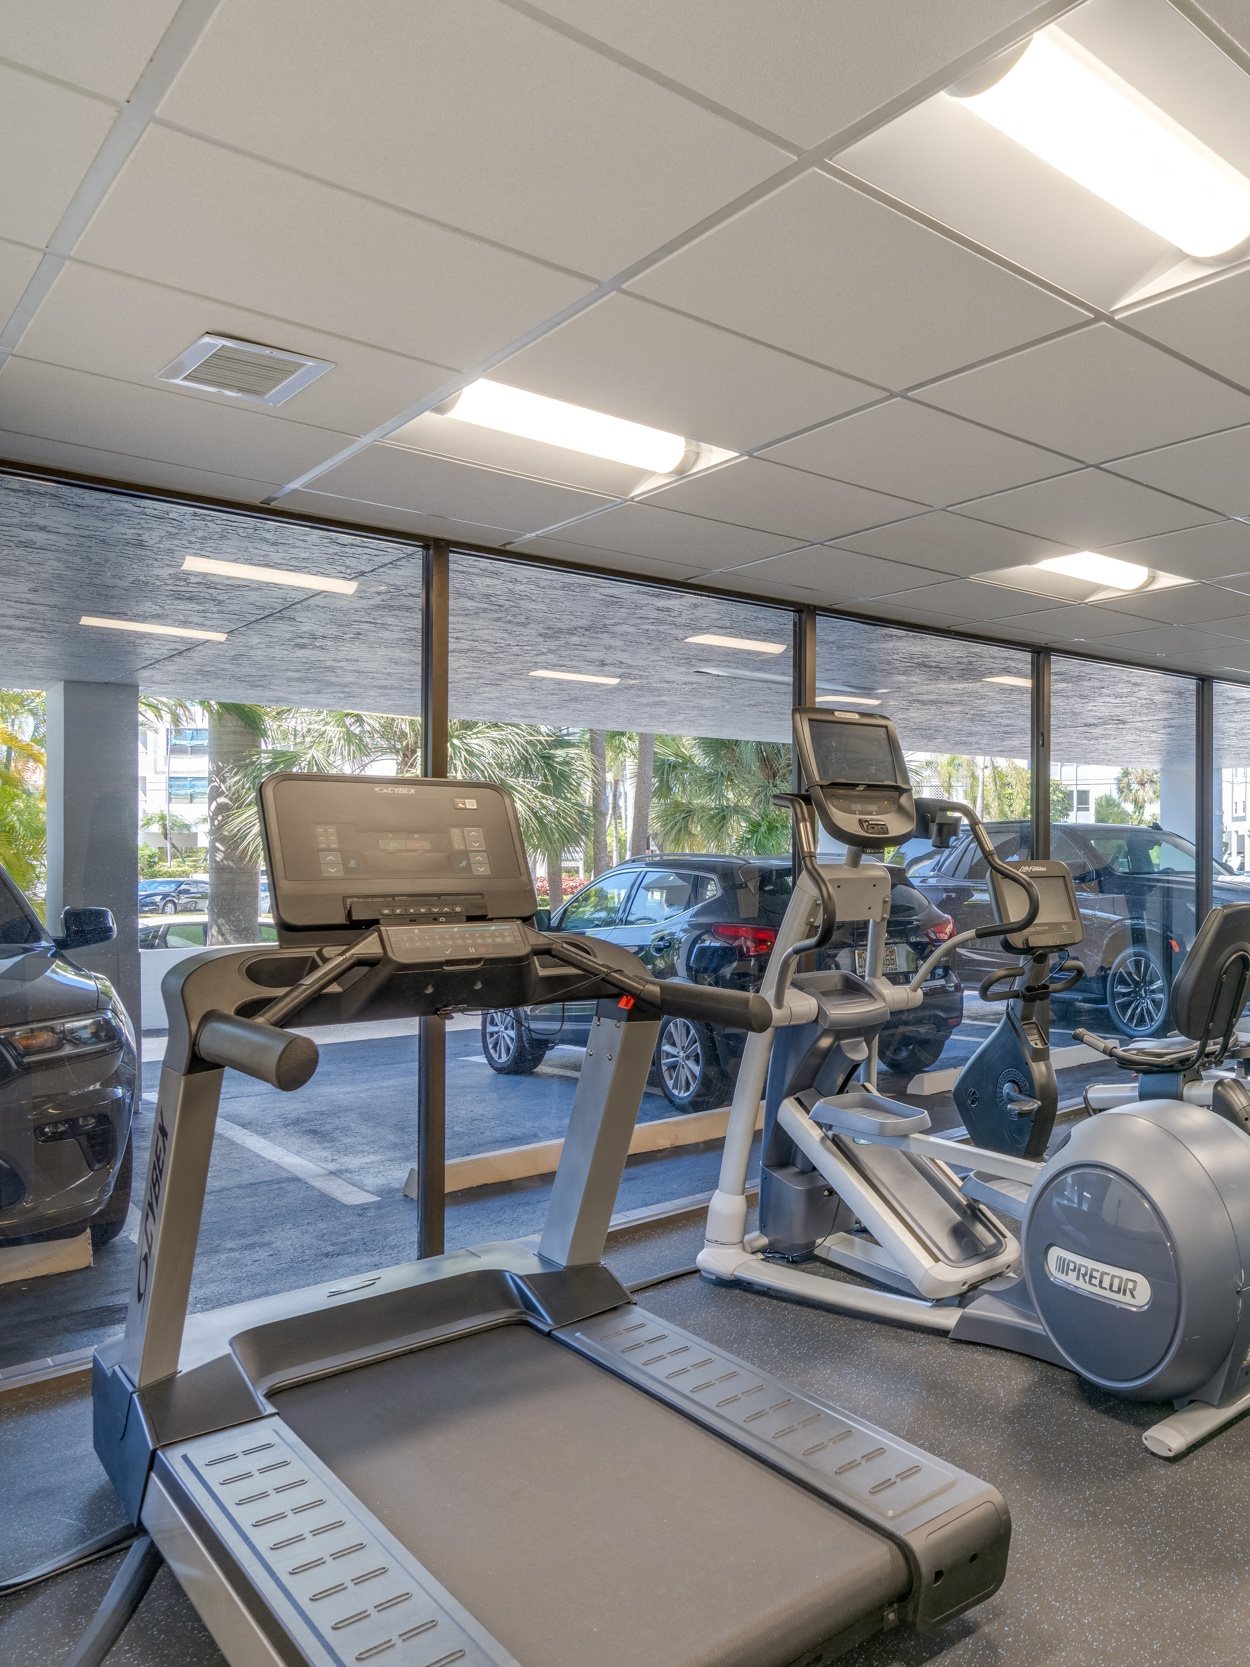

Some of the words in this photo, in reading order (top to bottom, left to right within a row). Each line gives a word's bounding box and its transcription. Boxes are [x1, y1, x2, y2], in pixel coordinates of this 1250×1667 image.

[387, 787, 416, 795] CYBEX
[145, 1104, 169, 1257] CYBEX
[1064, 1258, 1138, 1300] PRECOR
